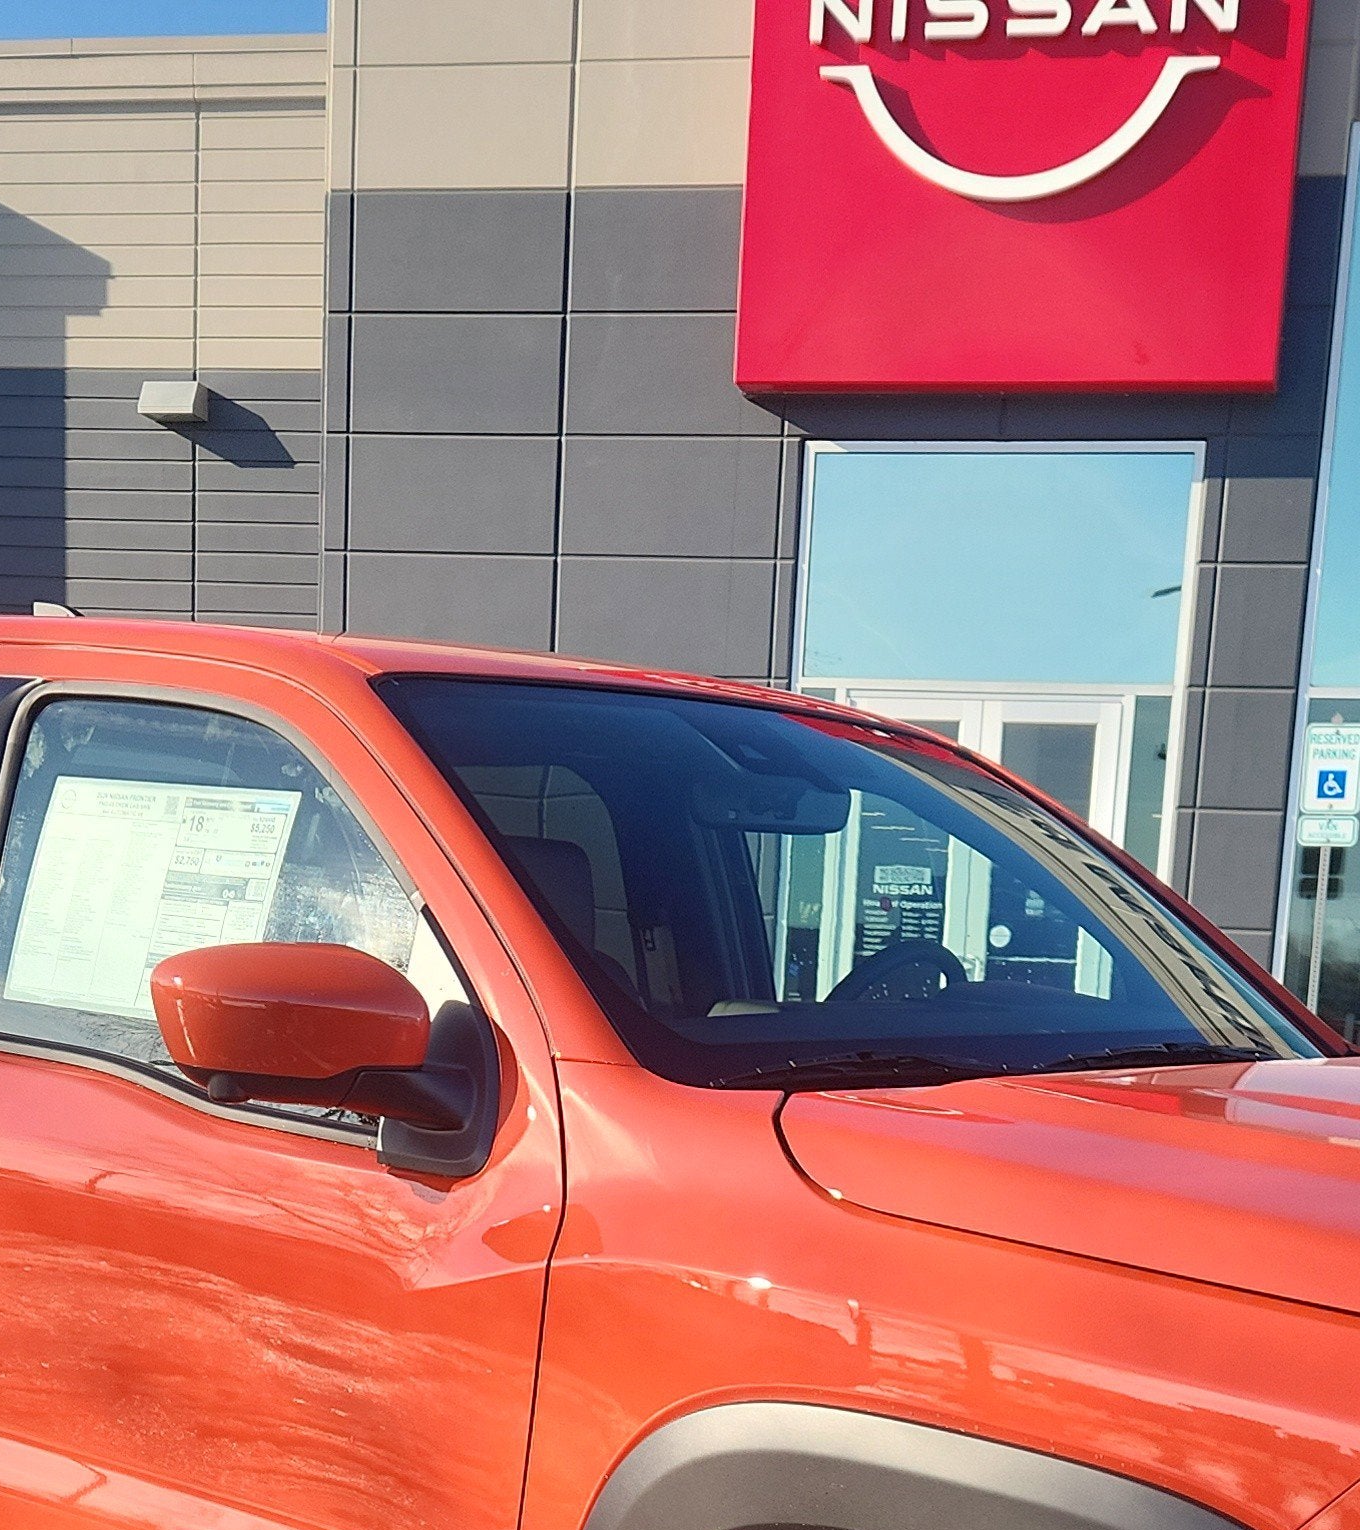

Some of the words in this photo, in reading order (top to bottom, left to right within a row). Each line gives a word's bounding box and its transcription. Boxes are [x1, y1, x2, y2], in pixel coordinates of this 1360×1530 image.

[809, 0, 1239, 45] NISSAN
[1312, 748, 1356, 760] PARKING
[872, 884, 933, 895] NISSAN
